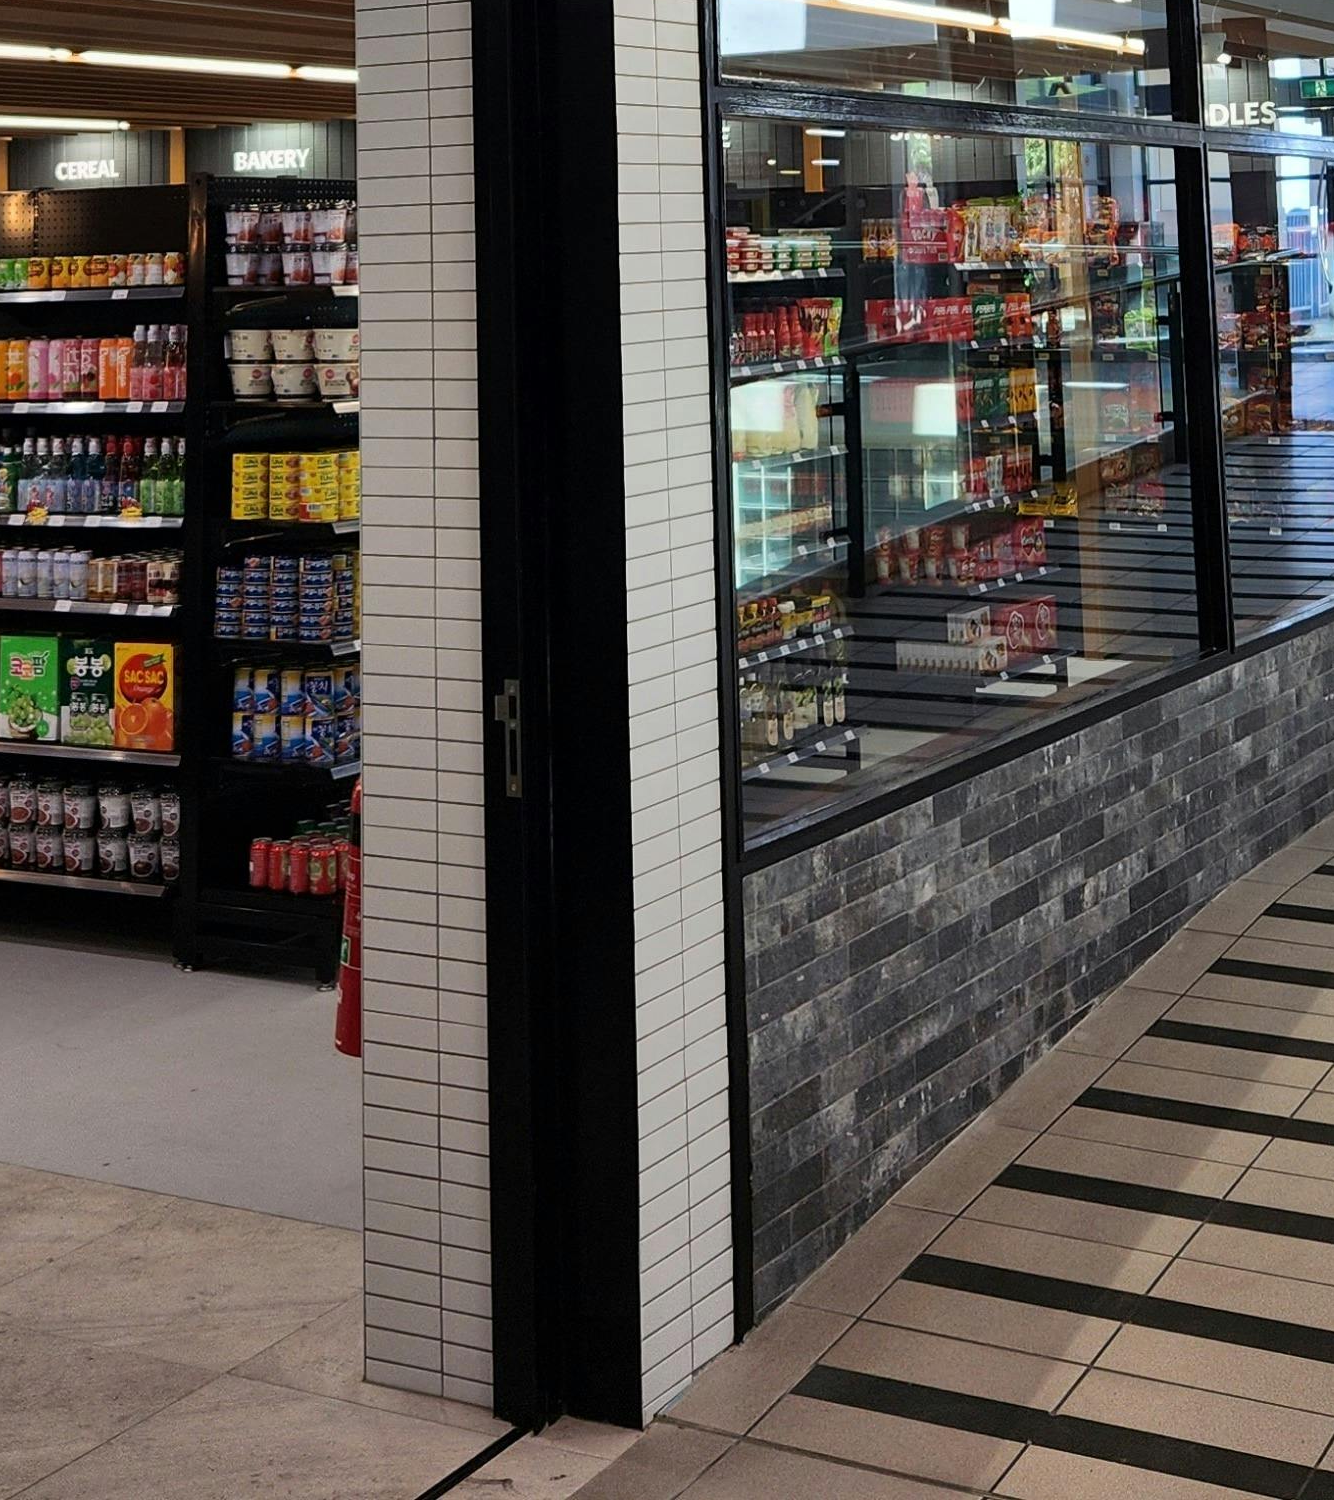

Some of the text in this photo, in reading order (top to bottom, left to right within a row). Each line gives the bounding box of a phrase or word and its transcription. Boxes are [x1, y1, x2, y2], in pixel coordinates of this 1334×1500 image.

[1205, 101, 1276, 127] DLES
[55, 159, 120, 181] CEREAL
[233, 148, 310, 172] BAKERY
[124, 669, 165, 685] SAC SAC
